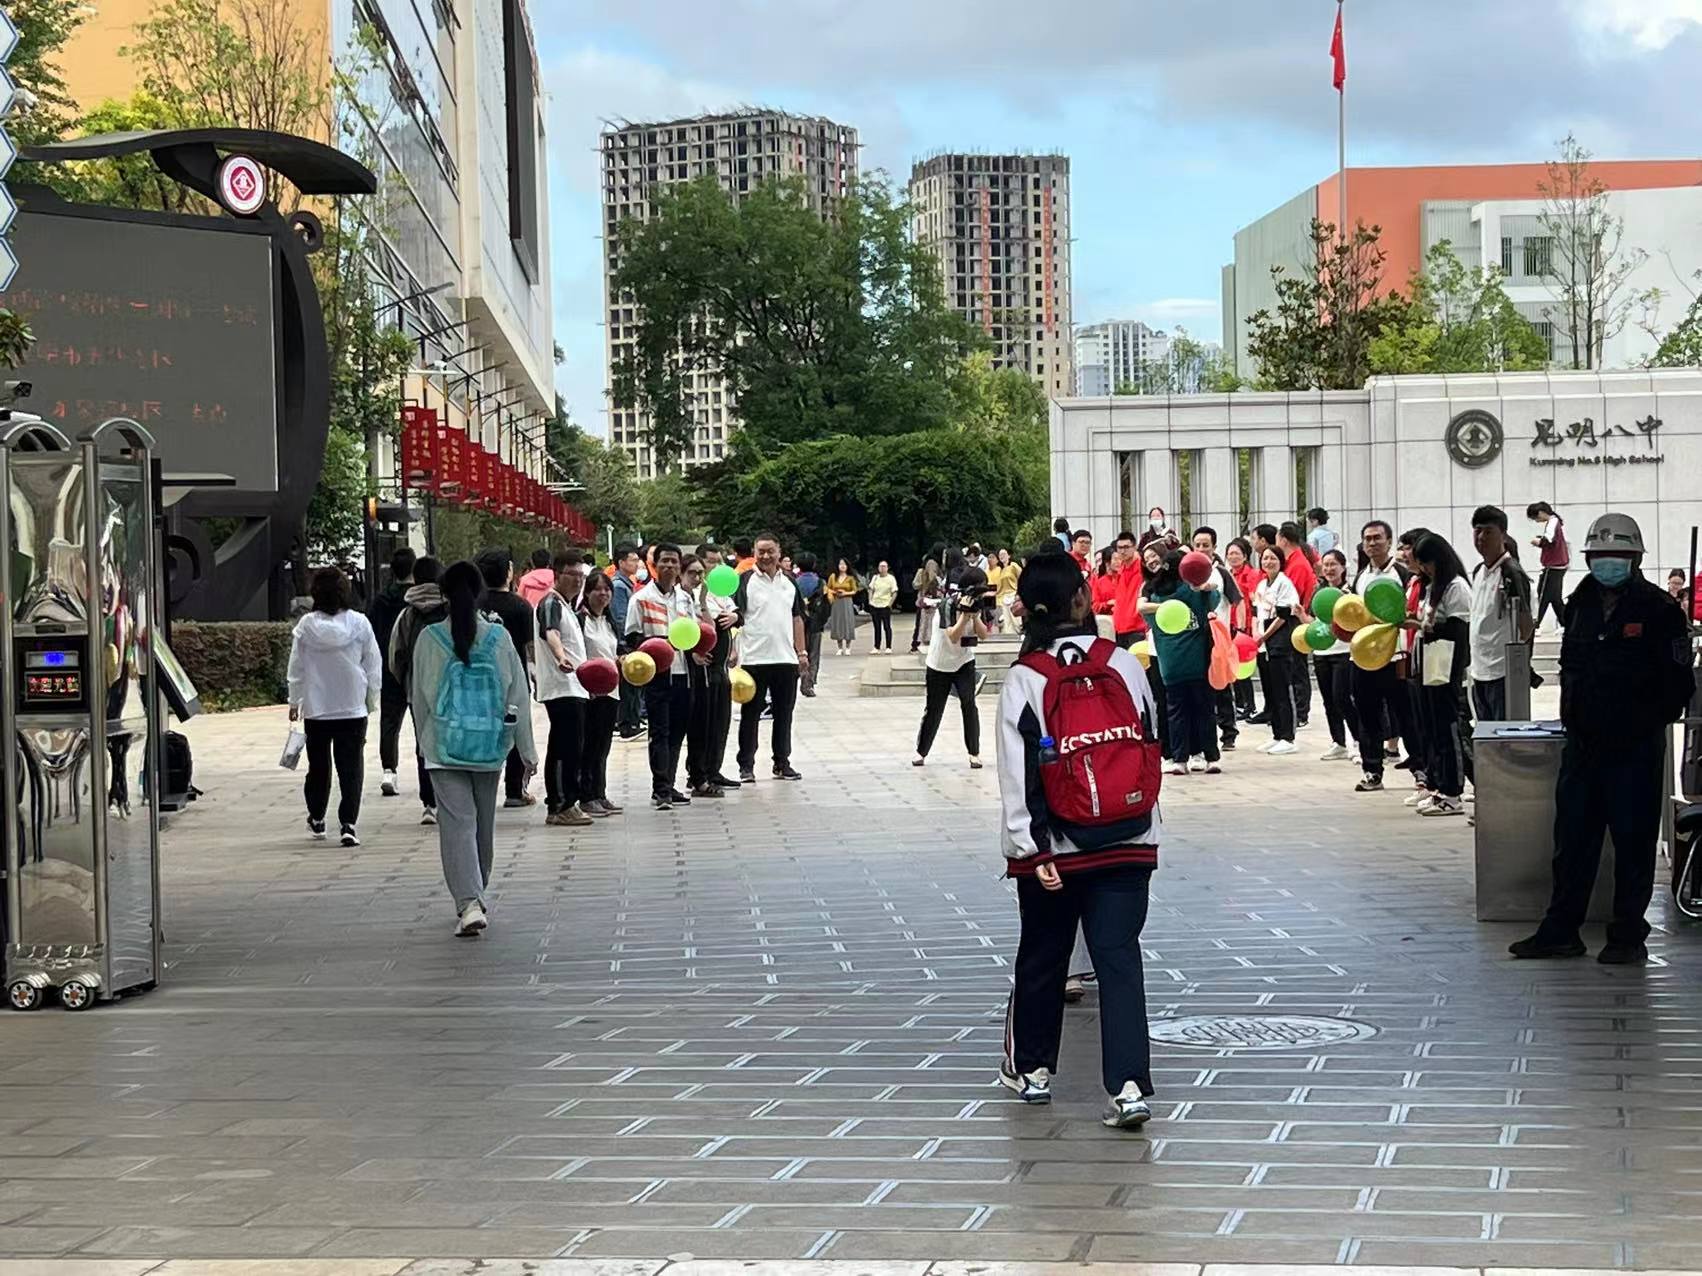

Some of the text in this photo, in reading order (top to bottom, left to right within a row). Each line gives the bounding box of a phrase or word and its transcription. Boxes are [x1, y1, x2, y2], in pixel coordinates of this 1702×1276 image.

[1531, 415, 1663, 449] 昆明八中
[1529, 457, 1575, 467] Kunming
[1603, 455, 1627, 467] High
[1628, 454, 1664, 465] School
[1060, 722, 1143, 754] ECSTATIC
